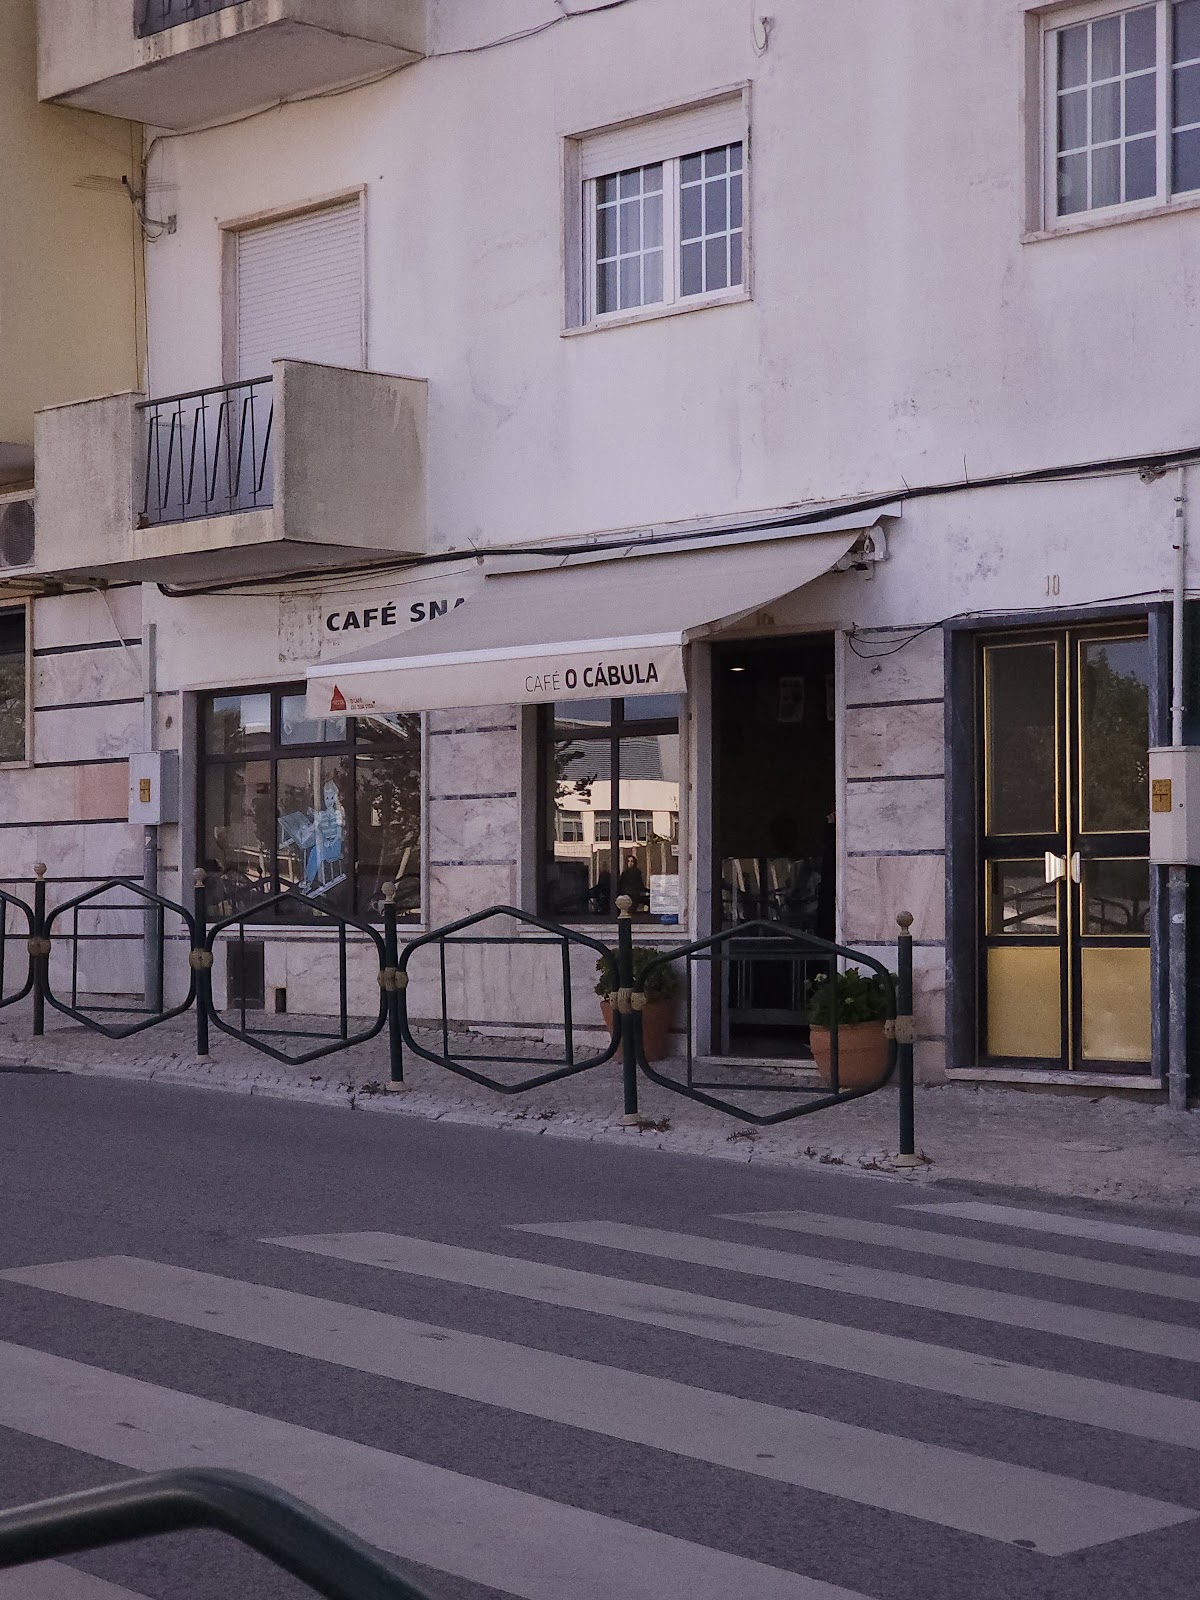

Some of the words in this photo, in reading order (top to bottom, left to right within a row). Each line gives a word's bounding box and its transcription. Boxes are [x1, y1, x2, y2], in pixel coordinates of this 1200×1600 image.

[1044, 574, 1060, 597] 10
[326, 600, 397, 632] CAFÉ
[525, 670, 561, 693] CAFÉ
[565, 668, 577, 689] O
[583, 661, 659, 688] CÁBULA
